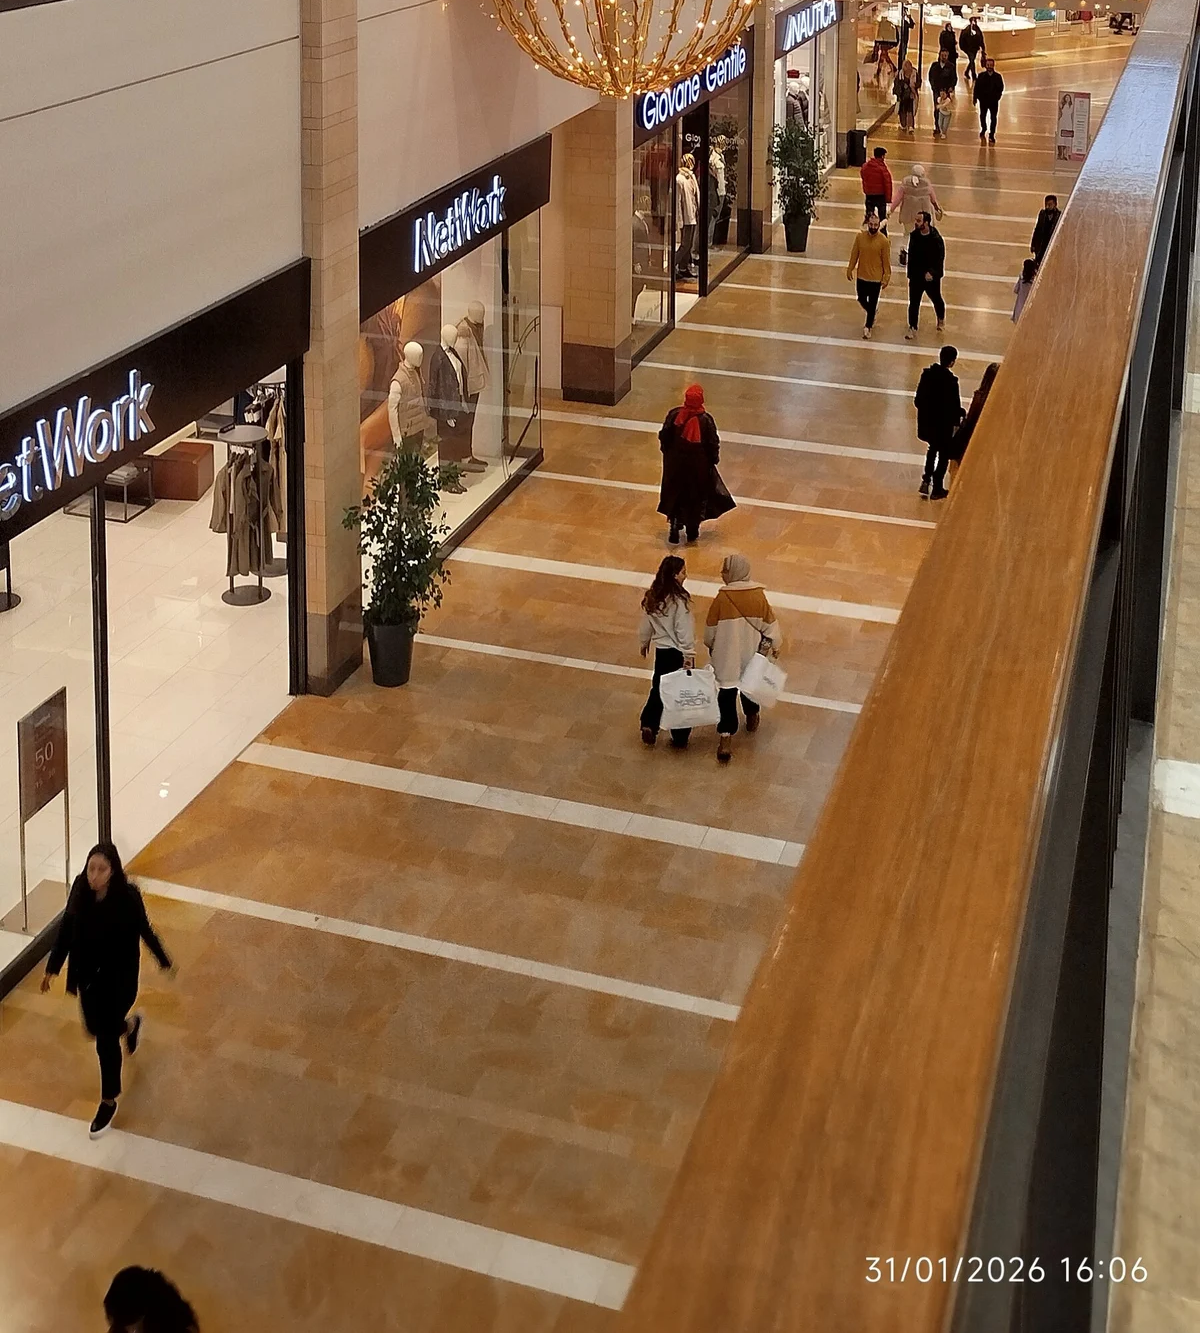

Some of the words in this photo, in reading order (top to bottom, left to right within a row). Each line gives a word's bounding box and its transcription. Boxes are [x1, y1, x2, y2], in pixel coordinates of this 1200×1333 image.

[783, 0, 837, 51] NAUTICA
[643, 73, 700, 130] Giovane
[705, 45, 746, 92] Gentile
[414, 174, 507, 274] NetWork
